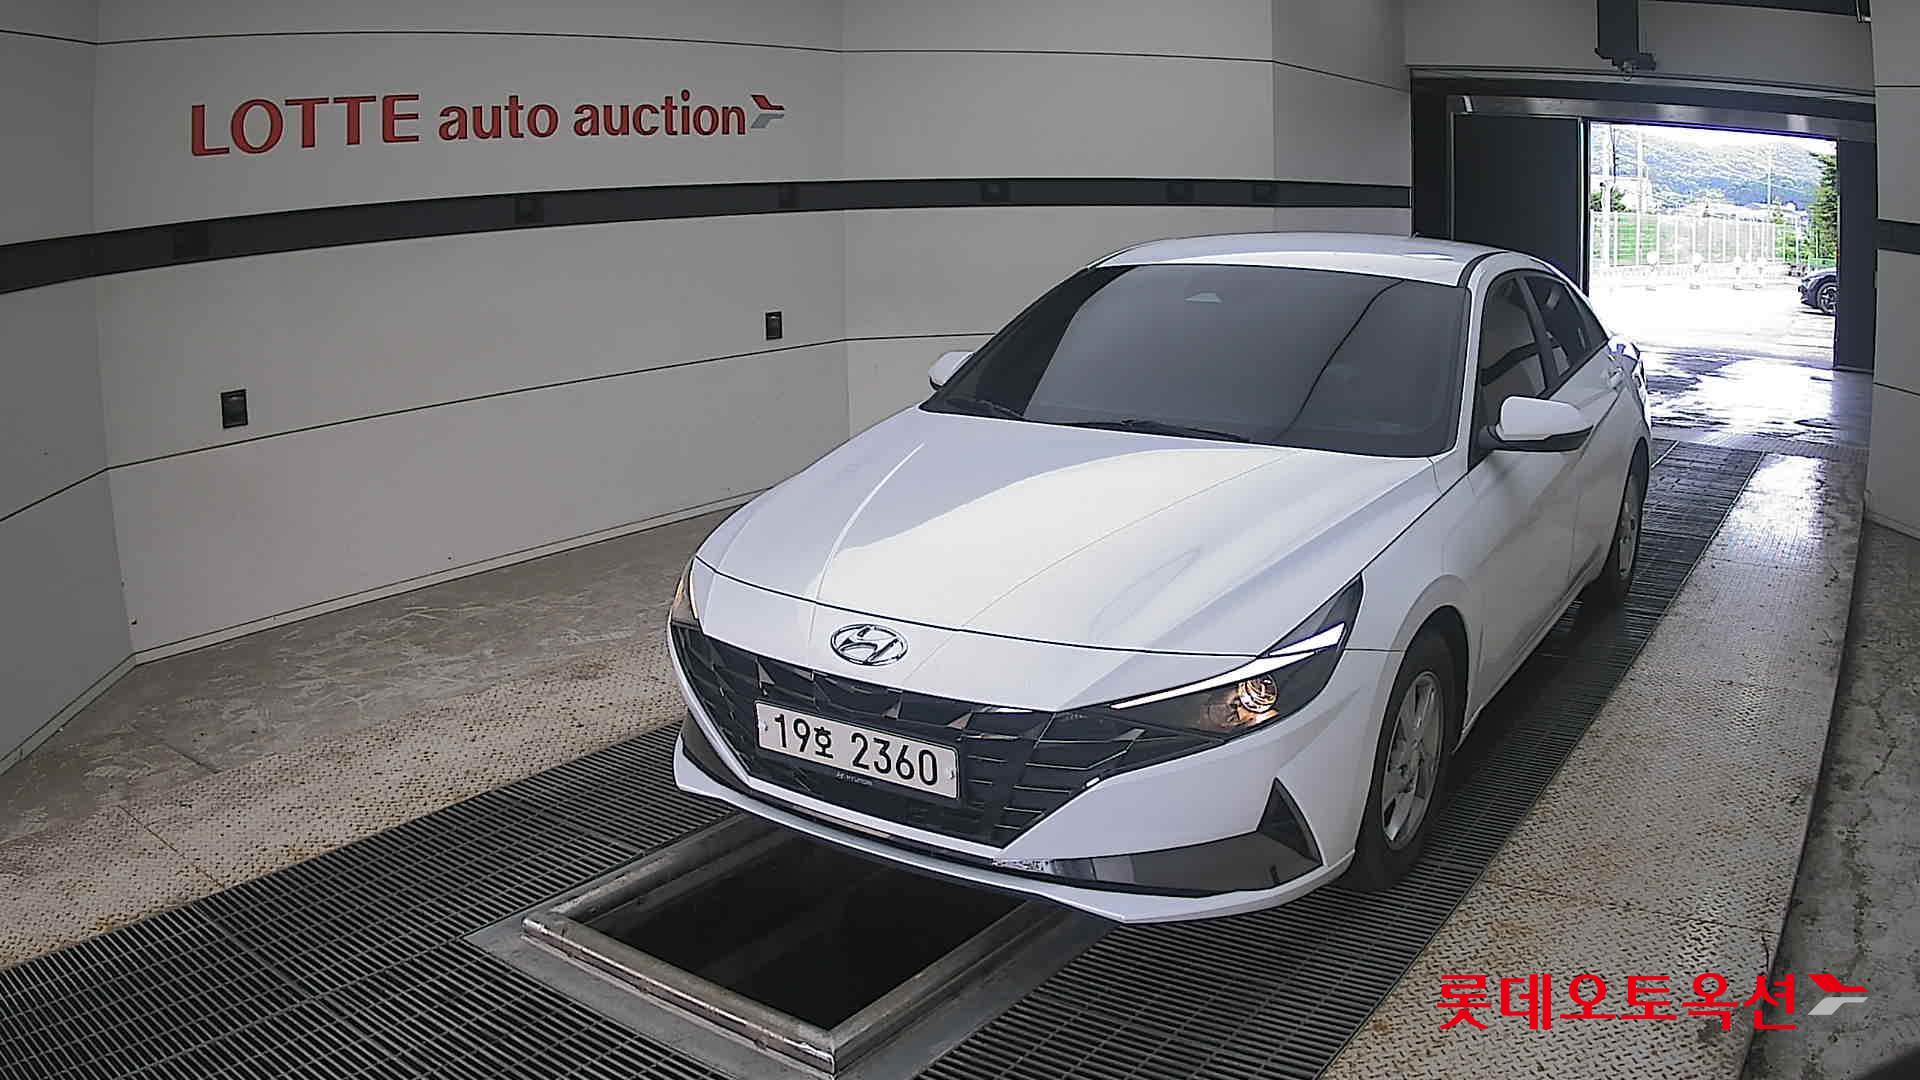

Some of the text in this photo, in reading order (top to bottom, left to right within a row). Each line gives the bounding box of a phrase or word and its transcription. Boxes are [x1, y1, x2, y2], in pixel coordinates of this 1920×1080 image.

[191, 89, 746, 157] LOTTE auto auction
[774, 713, 938, 786] 19호 2360
